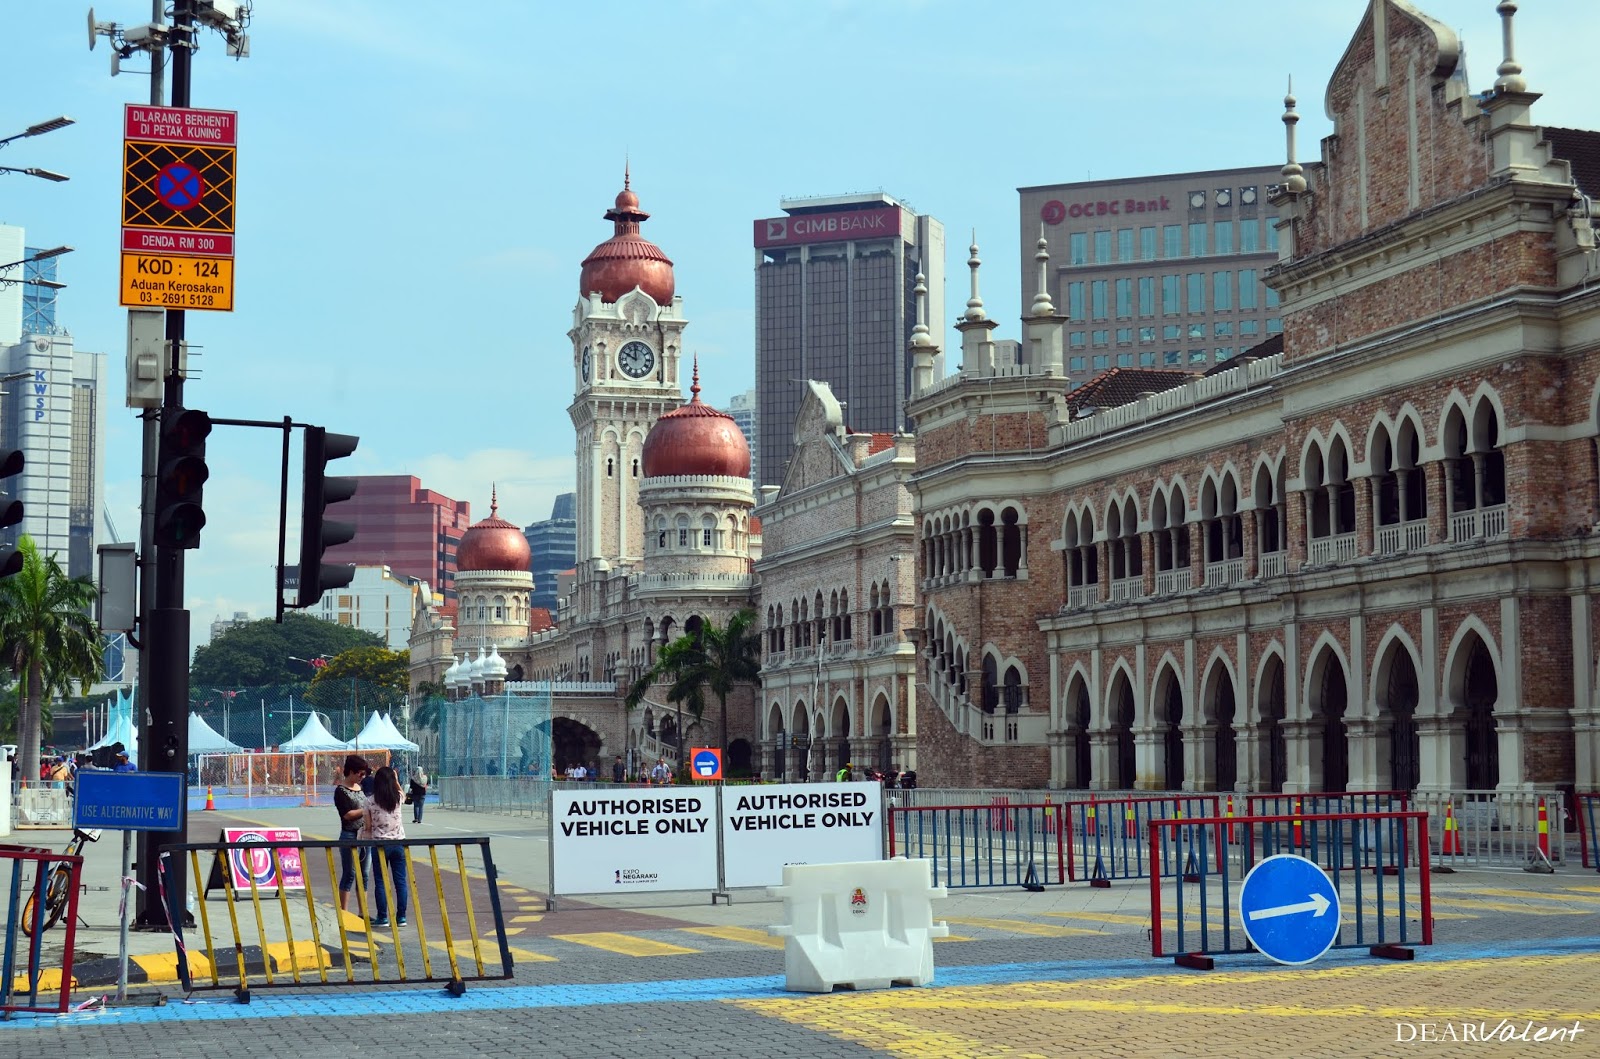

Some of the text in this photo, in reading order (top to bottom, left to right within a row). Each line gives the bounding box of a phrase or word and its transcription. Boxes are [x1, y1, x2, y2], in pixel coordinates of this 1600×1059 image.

[133, 110, 230, 127] DILARANG BERHENTI
[140, 123, 222, 139] DI PETAK KUNING
[1068, 195, 1170, 218] OCBC Bank
[793, 214, 886, 234] CIMB BANK
[142, 234, 215, 250] DENDA RM 300
[138, 257, 173, 275] KOD
[194, 261, 219, 278] 124
[130, 278, 224, 294] Aduan Kerosakan
[140, 291, 152, 302] 03
[162, 292, 186, 304] 2691
[189, 294, 214, 306] 5128
[34, 370, 47, 421] KWSP
[567, 798, 702, 816] AUTHORISED
[736, 792, 867, 811] AUTHORISED
[82, 805, 174, 820] USE ALTERNATIVE WAY
[730, 812, 874, 831] VEHICLE ONLY
[560, 818, 709, 837] VEHICLE ONLY
[284, 859, 300, 869] KL
